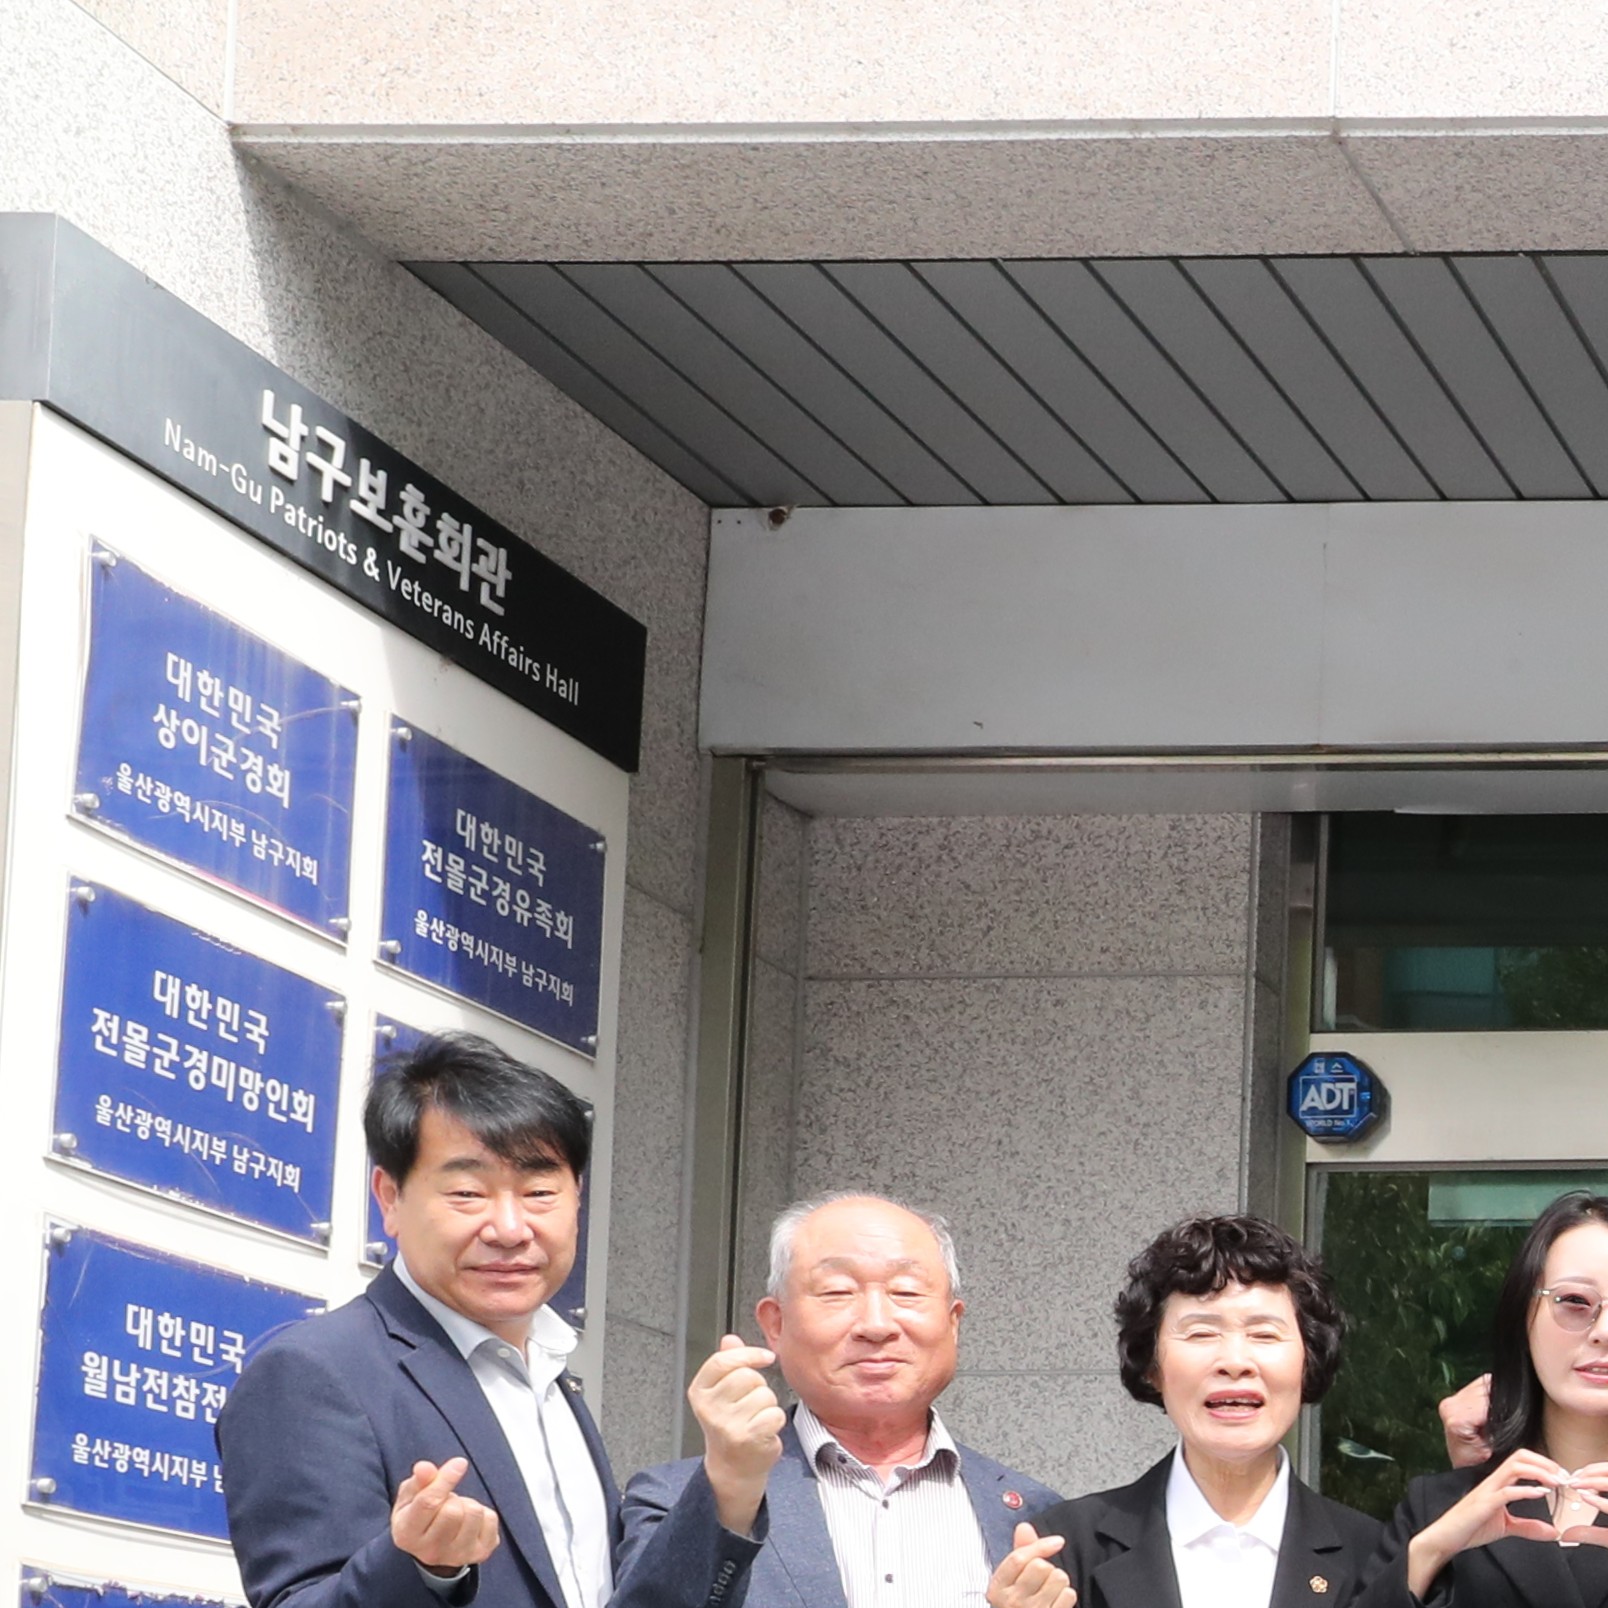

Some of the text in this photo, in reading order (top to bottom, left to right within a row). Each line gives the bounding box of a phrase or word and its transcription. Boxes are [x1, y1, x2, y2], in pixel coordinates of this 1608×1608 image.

[261, 389, 512, 616] 남구보훈회관
[164, 418, 579, 706] Nam-Gu Patriots & Veterans Affairs Hall
[166, 651, 282, 750] 대한민국
[152, 703, 291, 810] 상이군경회
[115, 762, 319, 886] 울산광역시지부 남구지회
[455, 808, 547, 888] 대한민국
[421, 839, 573, 950] 전몰군경유족회
[413, 909, 574, 1007] 울산광역시지부 남구지회
[153, 969, 270, 1056] 대한민국
[90, 1007, 316, 1134] 전몰군경미망인회
[1299, 1081, 1357, 1112] ADT
[94, 1094, 301, 1194] 울산광역시지부 남구지회
[81, 1351, 228, 1425] 월남전참전
[125, 1303, 247, 1375] 대한민국
[71, 1432, 208, 1489] 울산광역시지부
